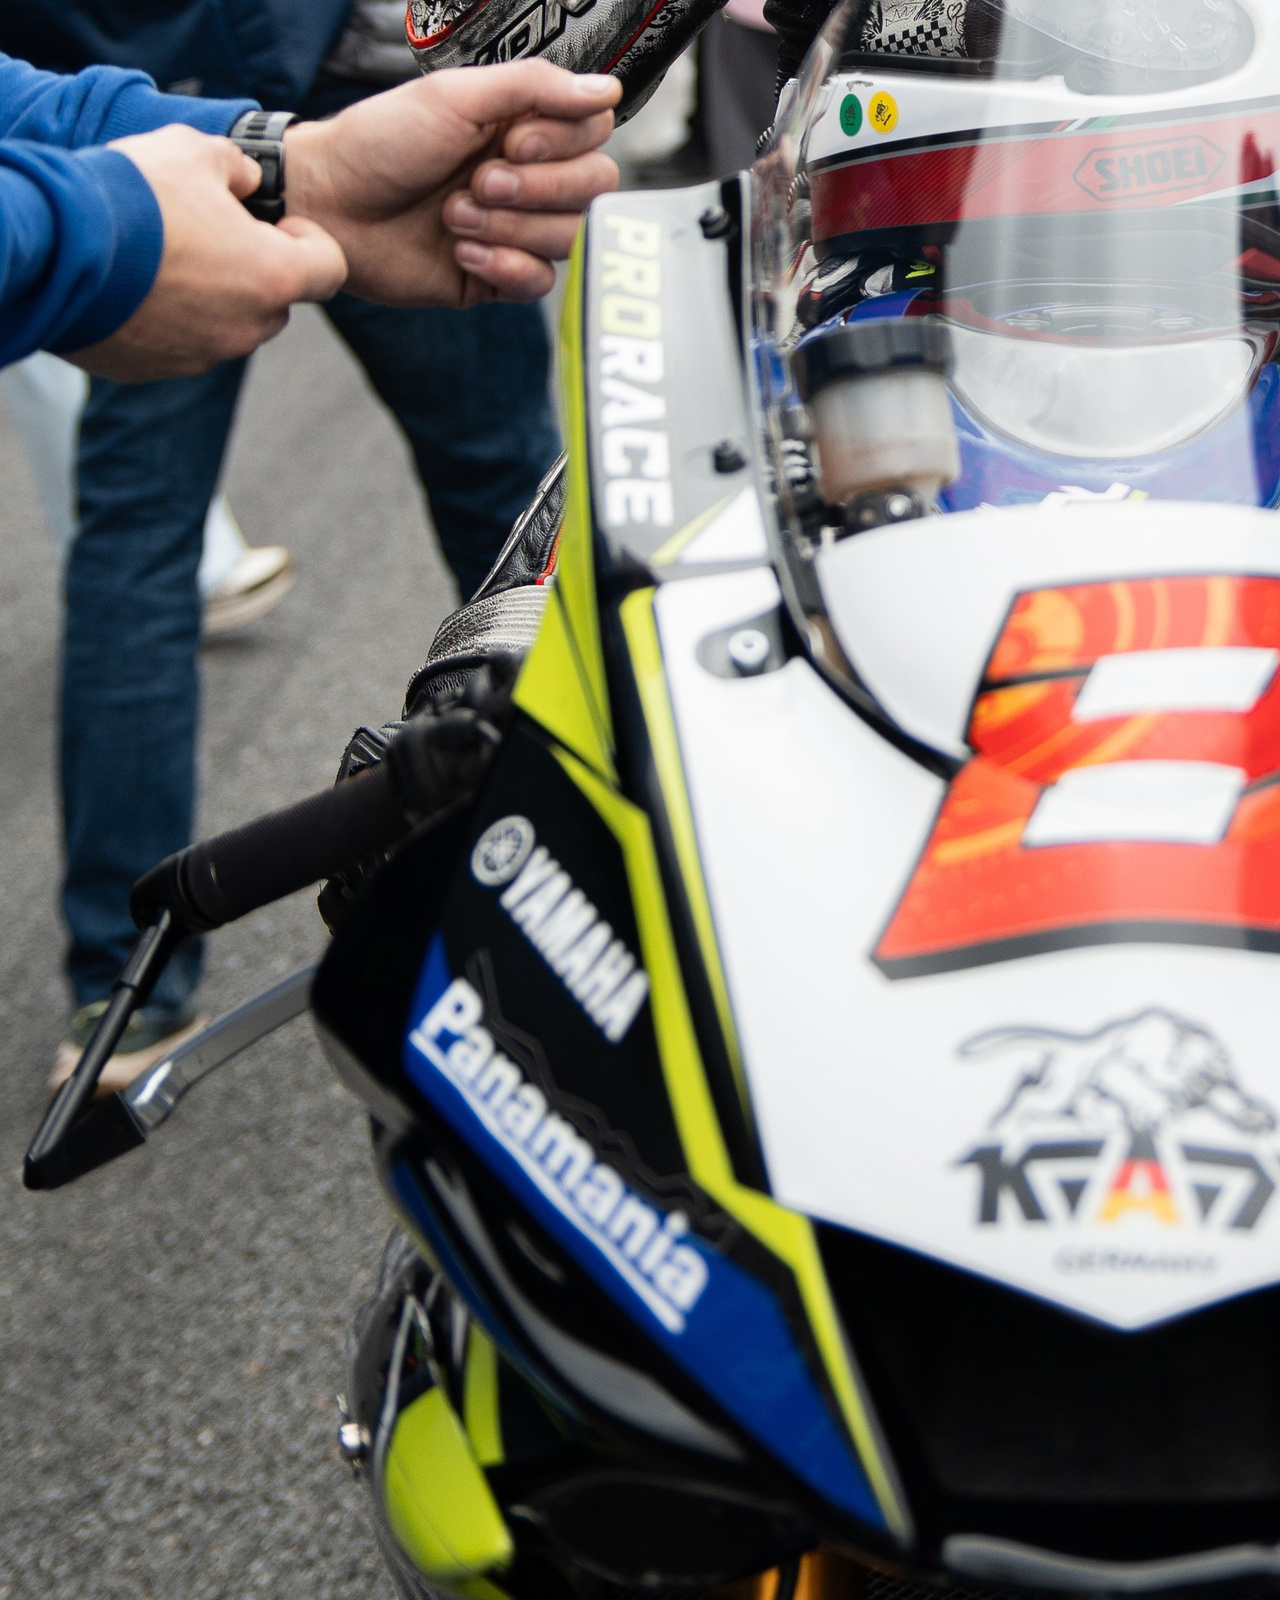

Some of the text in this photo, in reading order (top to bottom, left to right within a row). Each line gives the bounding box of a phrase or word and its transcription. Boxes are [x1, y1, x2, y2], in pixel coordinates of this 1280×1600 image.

[1094, 145, 1207, 192] SHOEI
[602, 212, 674, 528] PRORACE
[499, 845, 650, 1045] YAMAHA
[417, 976, 710, 1315] Panamania
